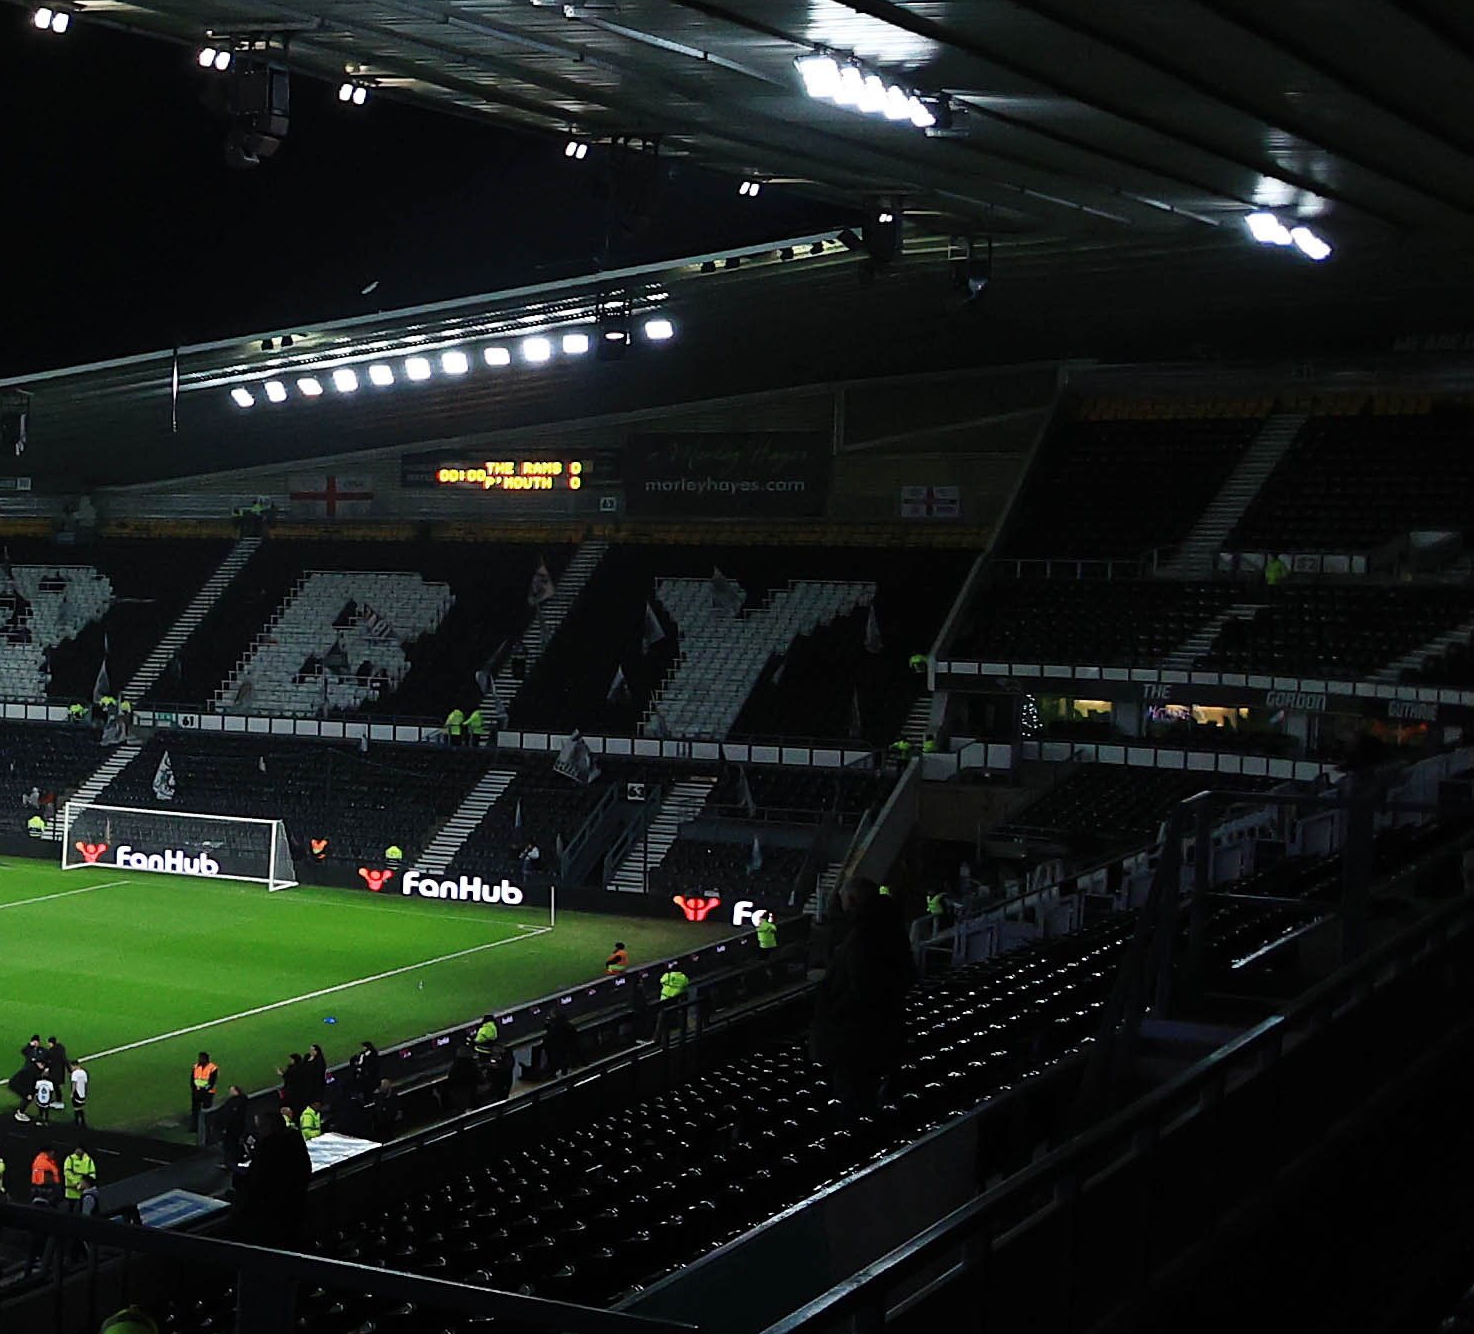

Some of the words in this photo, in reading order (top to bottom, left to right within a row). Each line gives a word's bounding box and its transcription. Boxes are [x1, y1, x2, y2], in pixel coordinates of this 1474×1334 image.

[437, 469, 486, 483] 00:00
[485, 461, 515, 475] THE
[521, 461, 562, 475] RAMS
[569, 461, 582, 475] 0
[484, 476, 553, 490] P'MOUTH
[569, 476, 581, 490] 0
[645, 476, 806, 496] morleyhayes.com
[1141, 682, 1173, 700] THE
[1265, 689, 1328, 711] GORDON
[115, 844, 223, 878] FanHub
[402, 870, 523, 907] FanHub
